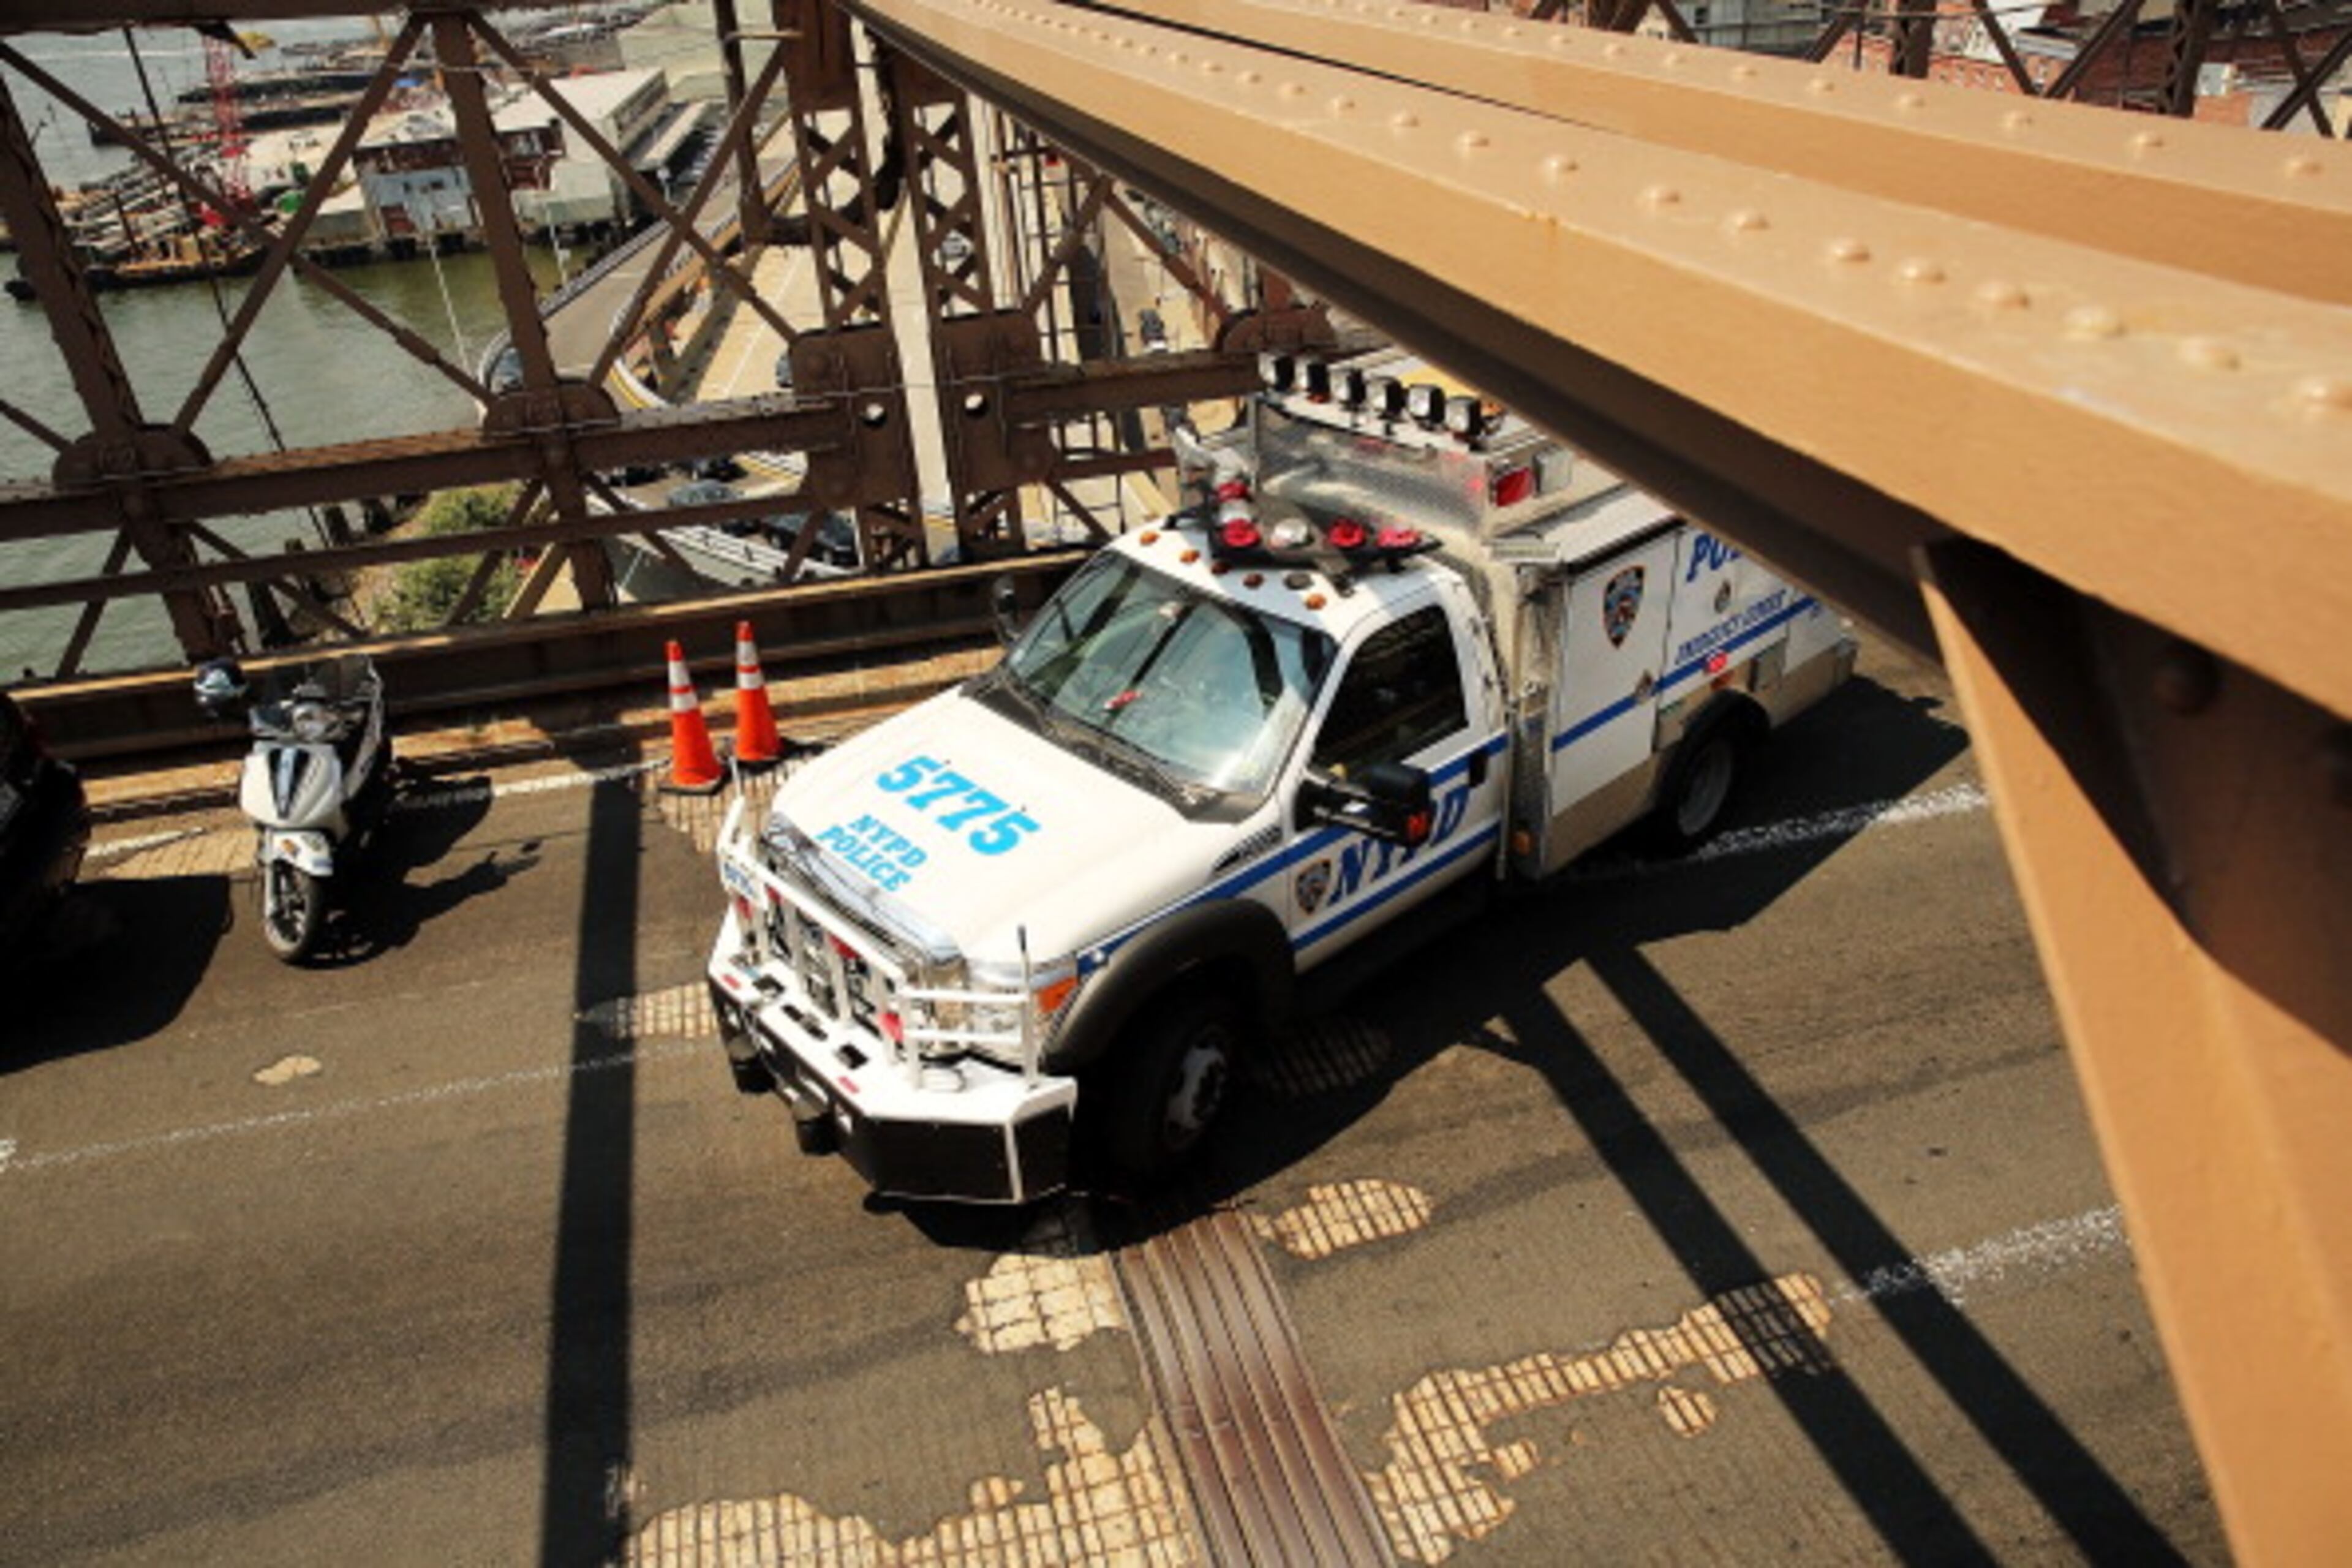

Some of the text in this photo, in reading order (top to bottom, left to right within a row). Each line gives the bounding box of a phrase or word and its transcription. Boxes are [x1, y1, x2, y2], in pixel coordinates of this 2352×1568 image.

[848, 814, 928, 868] NYPD
[876, 755, 1041, 855] 5775
[1327, 785, 1469, 906] NYD
[816, 826, 911, 892] POLICE
